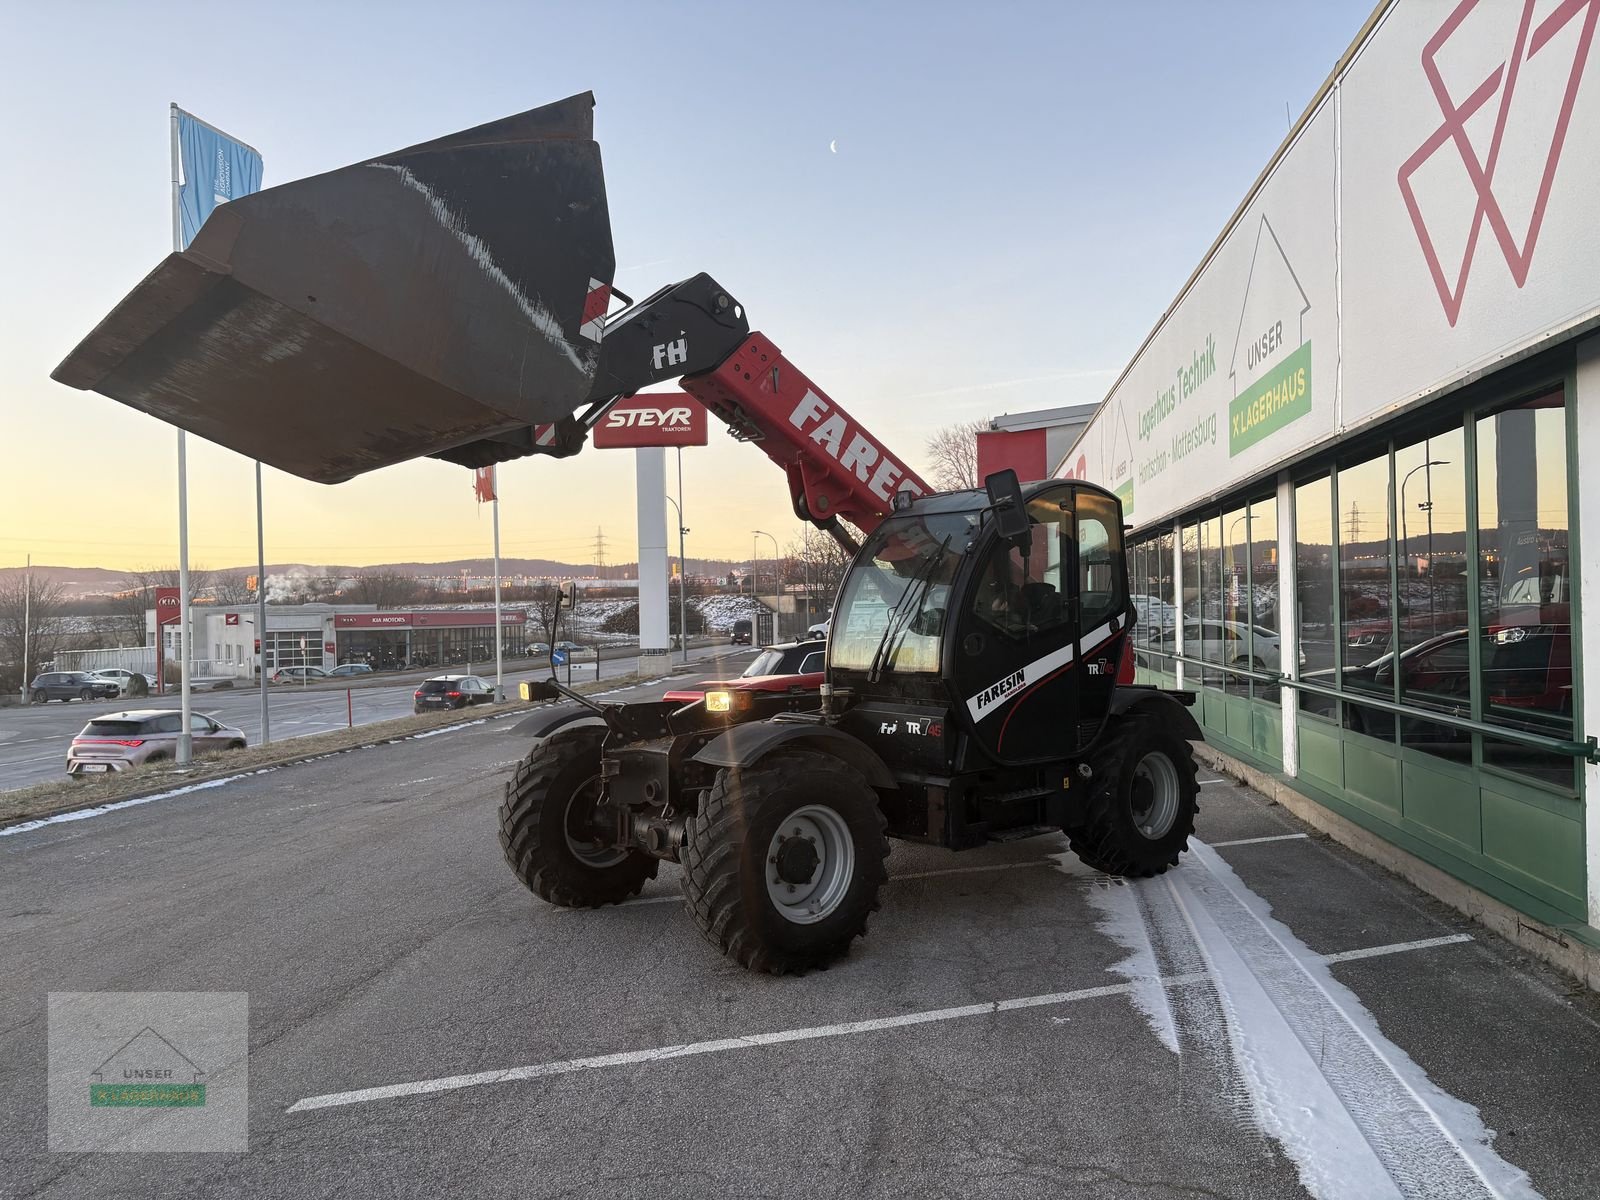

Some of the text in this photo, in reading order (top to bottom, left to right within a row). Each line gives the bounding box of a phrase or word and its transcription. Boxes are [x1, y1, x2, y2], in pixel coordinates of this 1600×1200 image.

[1247, 320, 1283, 371] UNSER
[1138, 332, 1216, 441] Lagerhaus Technik
[1240, 367, 1306, 433] LAGERHAUS
[605, 407, 692, 428] STEYR
[1172, 412, 1217, 464] Mattersburg
[976, 668, 1025, 710] FARESIN
